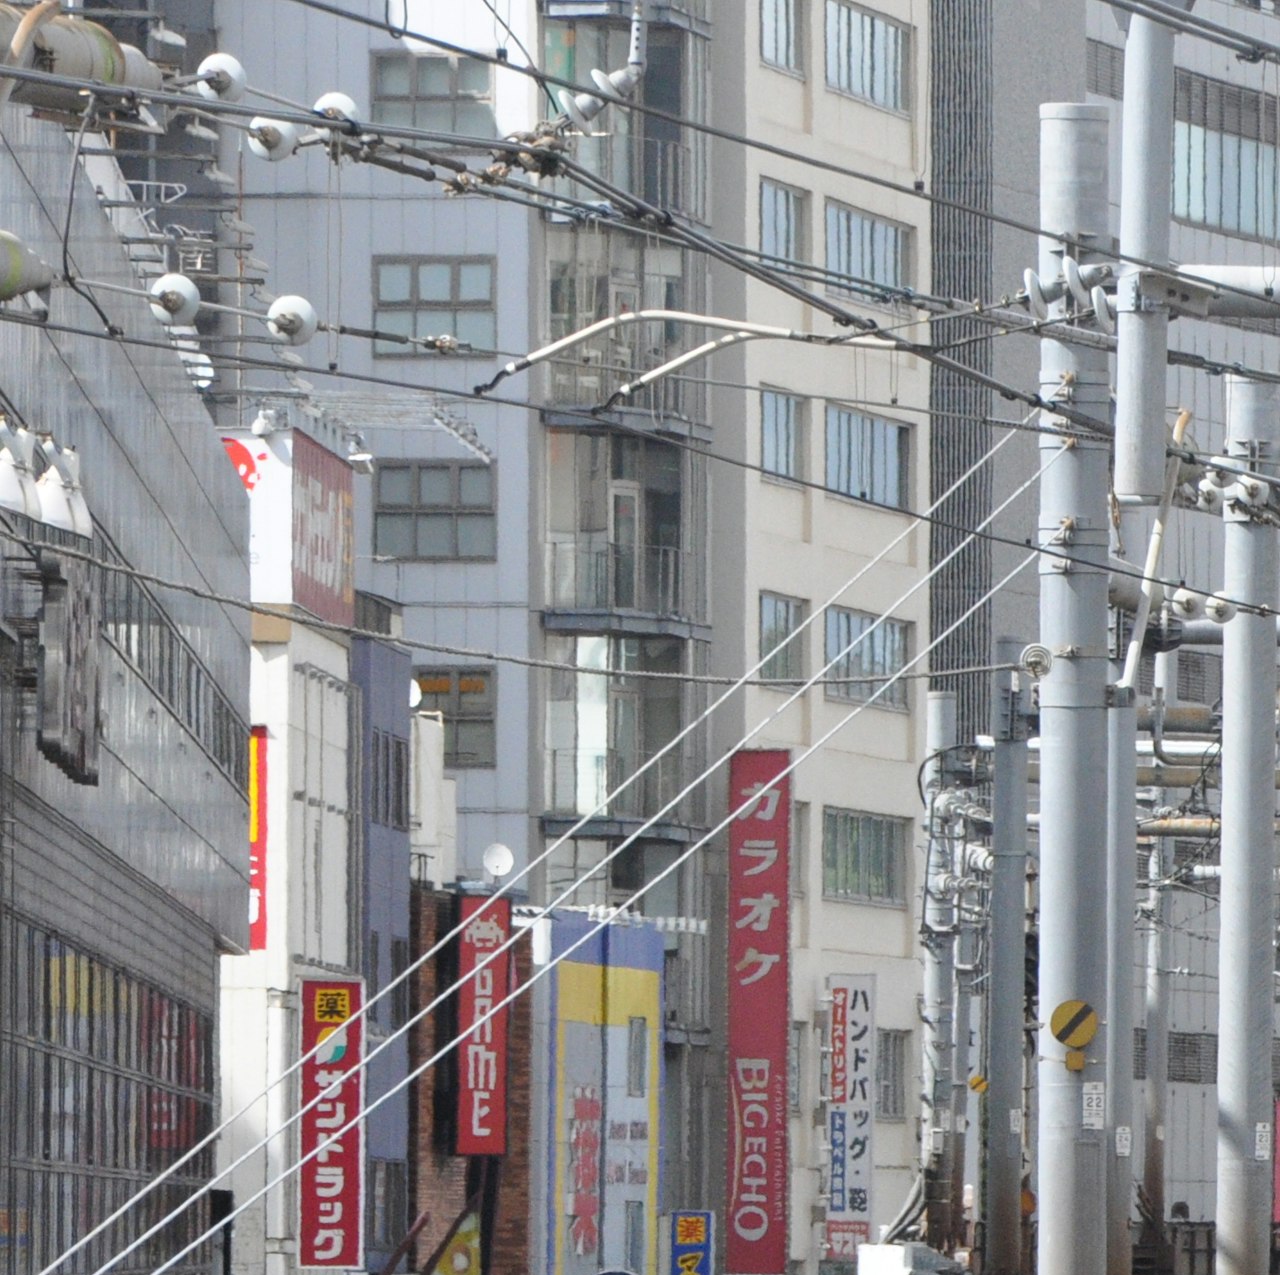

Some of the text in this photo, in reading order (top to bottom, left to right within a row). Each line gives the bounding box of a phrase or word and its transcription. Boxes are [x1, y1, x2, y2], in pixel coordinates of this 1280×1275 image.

[735, 782, 781, 986] カラオケ
[318, 991, 347, 1020] 薬
[467, 951, 498, 1137] GAME
[313, 1069, 348, 1261] サンドラッグ
[734, 1057, 770, 1242] BIG ECHO
[1086, 1096, 1103, 1108] 22
